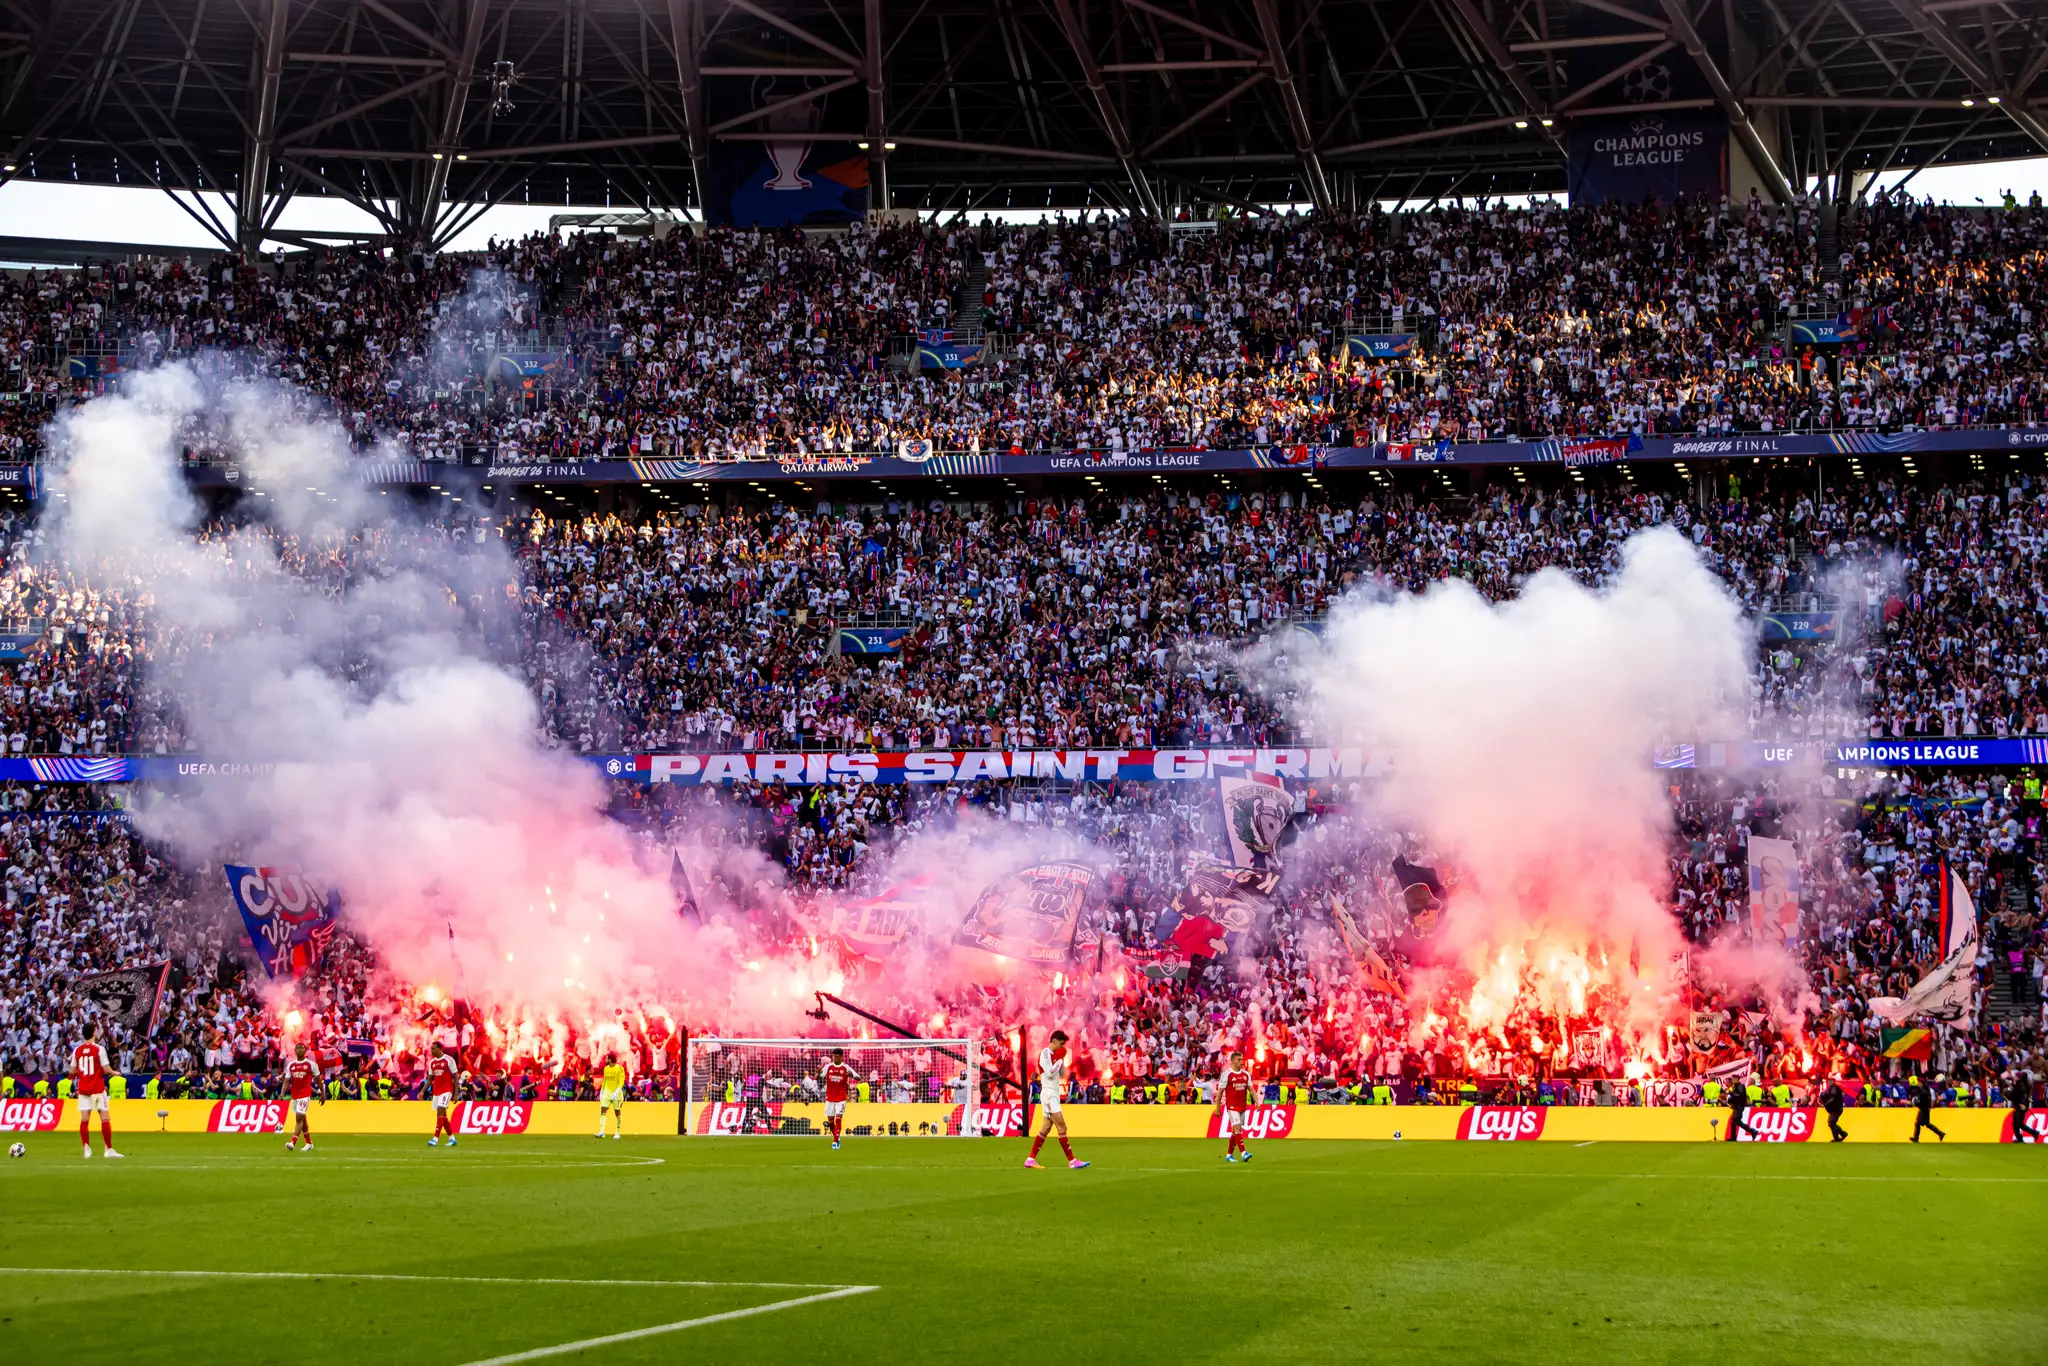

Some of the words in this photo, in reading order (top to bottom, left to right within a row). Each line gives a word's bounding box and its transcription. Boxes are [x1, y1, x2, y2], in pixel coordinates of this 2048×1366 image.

[1630, 118, 1664, 132] UEFA
[1594, 132, 1703, 152] CHAMPIONS
[1613, 150, 1684, 167] LEAGUE
[1819, 327, 1833, 336] 329
[1374, 342, 1389, 350] 330
[945, 353, 958, 361] 331
[524, 360, 538, 369] 332
[1673, 442, 1718, 454] BUDAPEST
[1718, 441, 1732, 451] 26
[1736, 440, 1779, 450] FINAL
[1415, 448, 1454, 461] Fedx
[1051, 458, 1081, 468] UEFA
[1084, 456, 1152, 468] CHAMPIONS
[1156, 455, 1200, 466] LEAGUE
[487, 466, 530, 478] BUDAPEST
[530, 465, 543, 476] 26
[546, 465, 586, 476] FINAL
[781, 464, 818, 474] QATAR
[817, 463, 860, 473] AIRWAYS
[1793, 621, 1809, 630] 229
[1, 642, 16, 650] 233
[868, 636, 883, 645] 231
[1914, 745, 1979, 760] LEAGUE
[179, 763, 217, 775] UEFA
[651, 753, 879, 783] PARIS
[904, 750, 1129, 781] SAINT
[79, 1055, 95, 1076] 41
[217, 1099, 279, 1133] Lay's
[459, 1100, 523, 1134] Lay's
[1218, 1104, 1286, 1139] Ly's
[1468, 1105, 1537, 1140] Lay's
[1737, 1106, 1807, 1142] Lay's
